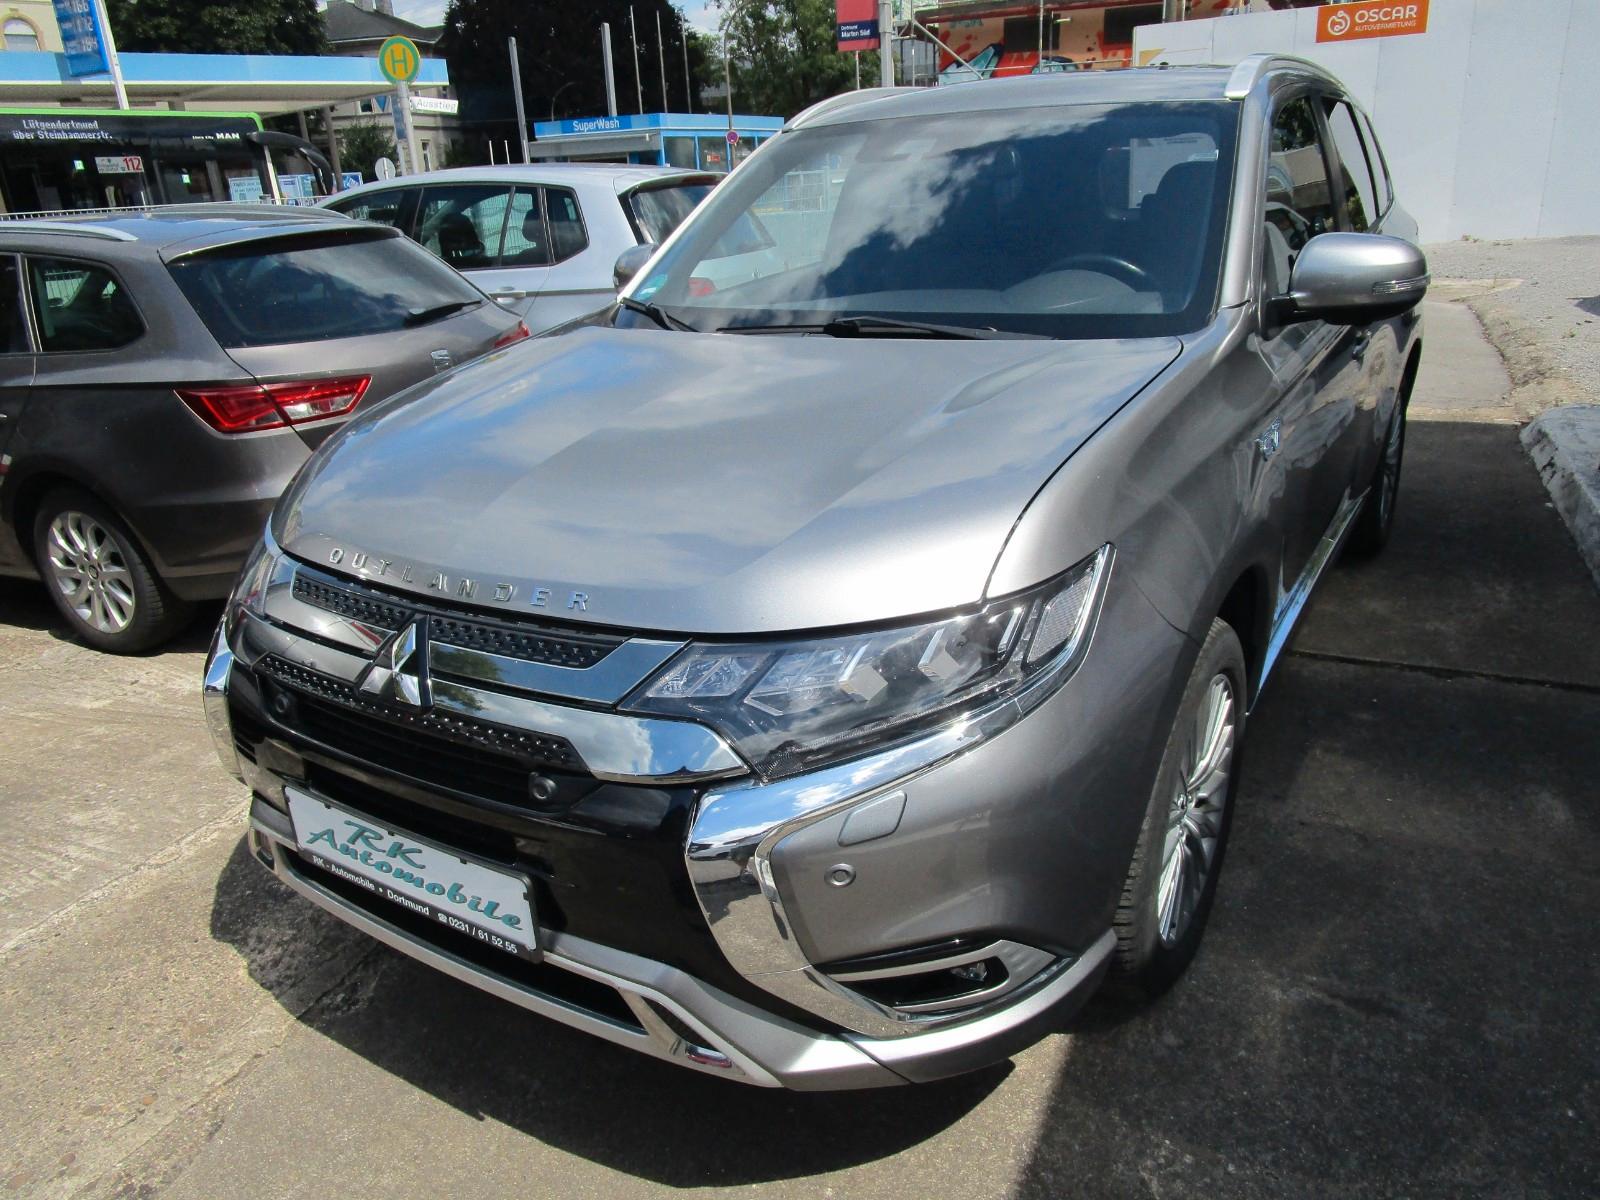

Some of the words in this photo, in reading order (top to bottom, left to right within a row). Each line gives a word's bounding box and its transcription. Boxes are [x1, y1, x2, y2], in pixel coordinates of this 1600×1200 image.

[1354, 5, 1418, 23] OSCAR
[1354, 19, 1417, 32] AUTOVERMIETUNG
[390, 48, 409, 75] H
[416, 98, 456, 112] Ausstieg
[22, 119, 99, 130] Lütgendortmund
[572, 118, 620, 133] SuperWash
[12, 129, 35, 139] über
[37, 129, 113, 139] Steinhammerstr.
[215, 132, 240, 140] MAN
[123, 157, 142, 171] 112
[328, 547, 591, 612] OUTLANDER
[343, 819, 427, 869] RK
[305, 827, 523, 931] Automobile
[312, 855, 325, 868] RK
[331, 864, 375, 891] Automobile
[387, 889, 430, 916] Dortmund
[448, 916, 471, 934] 0231
[478, 929, 489, 941] 61
[491, 935, 503, 948] 52
[505, 940, 518, 954] 55
